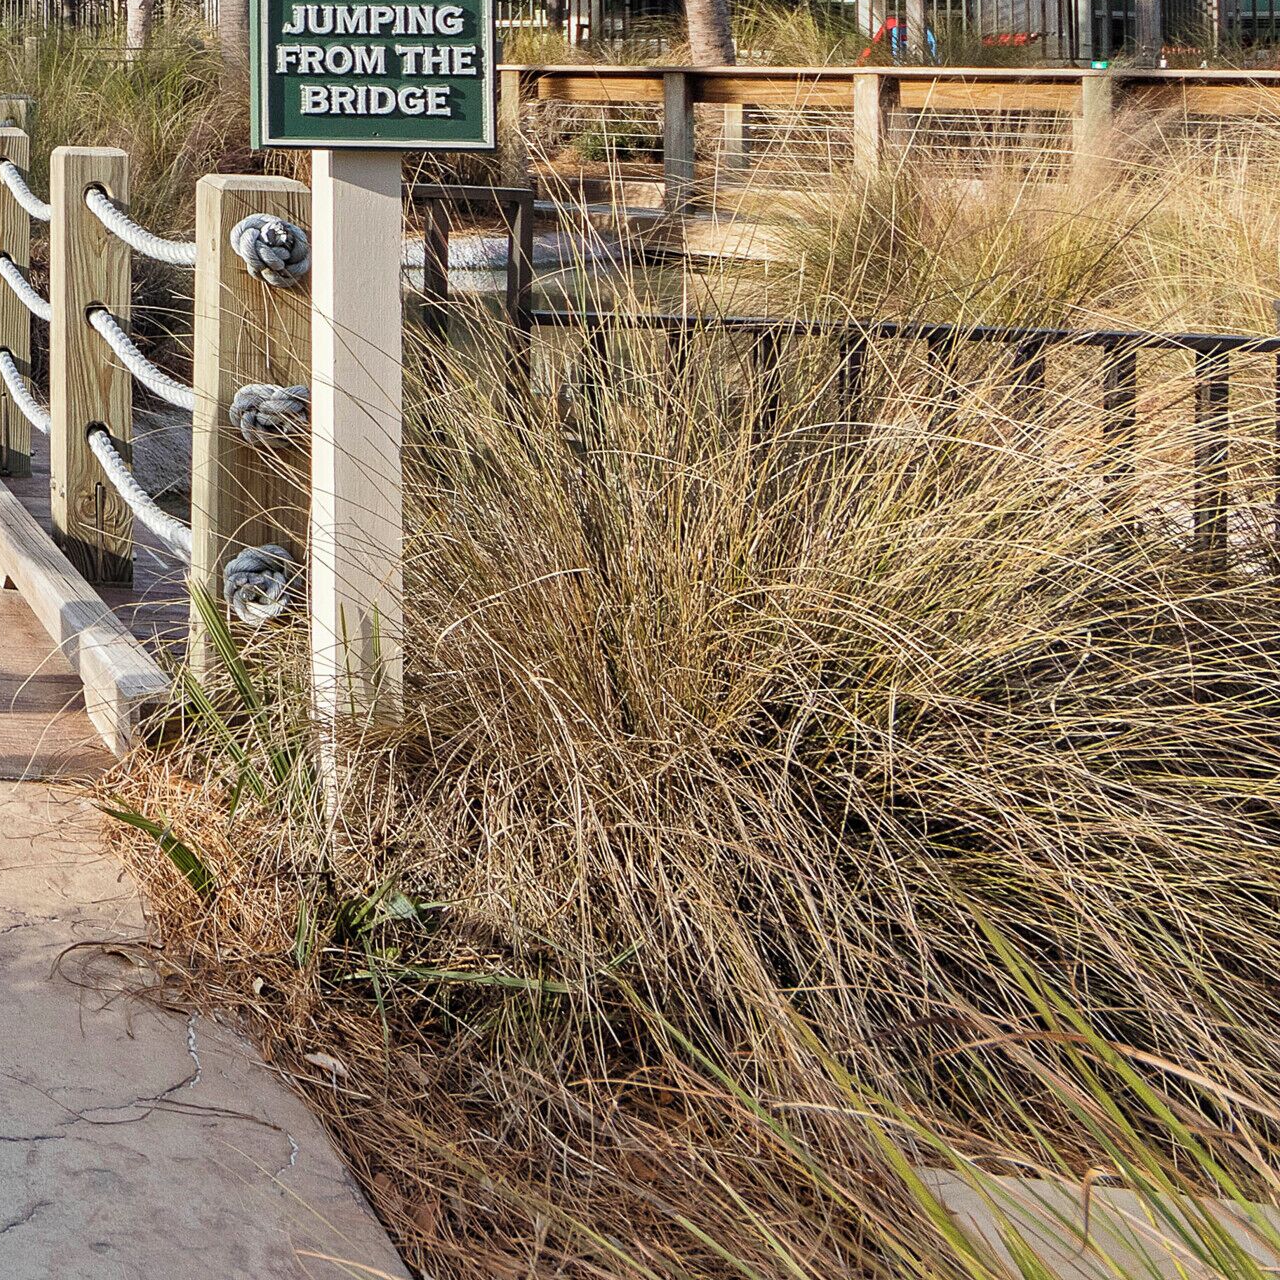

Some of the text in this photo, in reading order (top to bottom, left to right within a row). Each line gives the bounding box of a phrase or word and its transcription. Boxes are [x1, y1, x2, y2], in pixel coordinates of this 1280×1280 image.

[282, 4, 465, 35] JUMPING
[275, 43, 477, 75] FROM THE
[300, 84, 452, 116] BRIDGE
